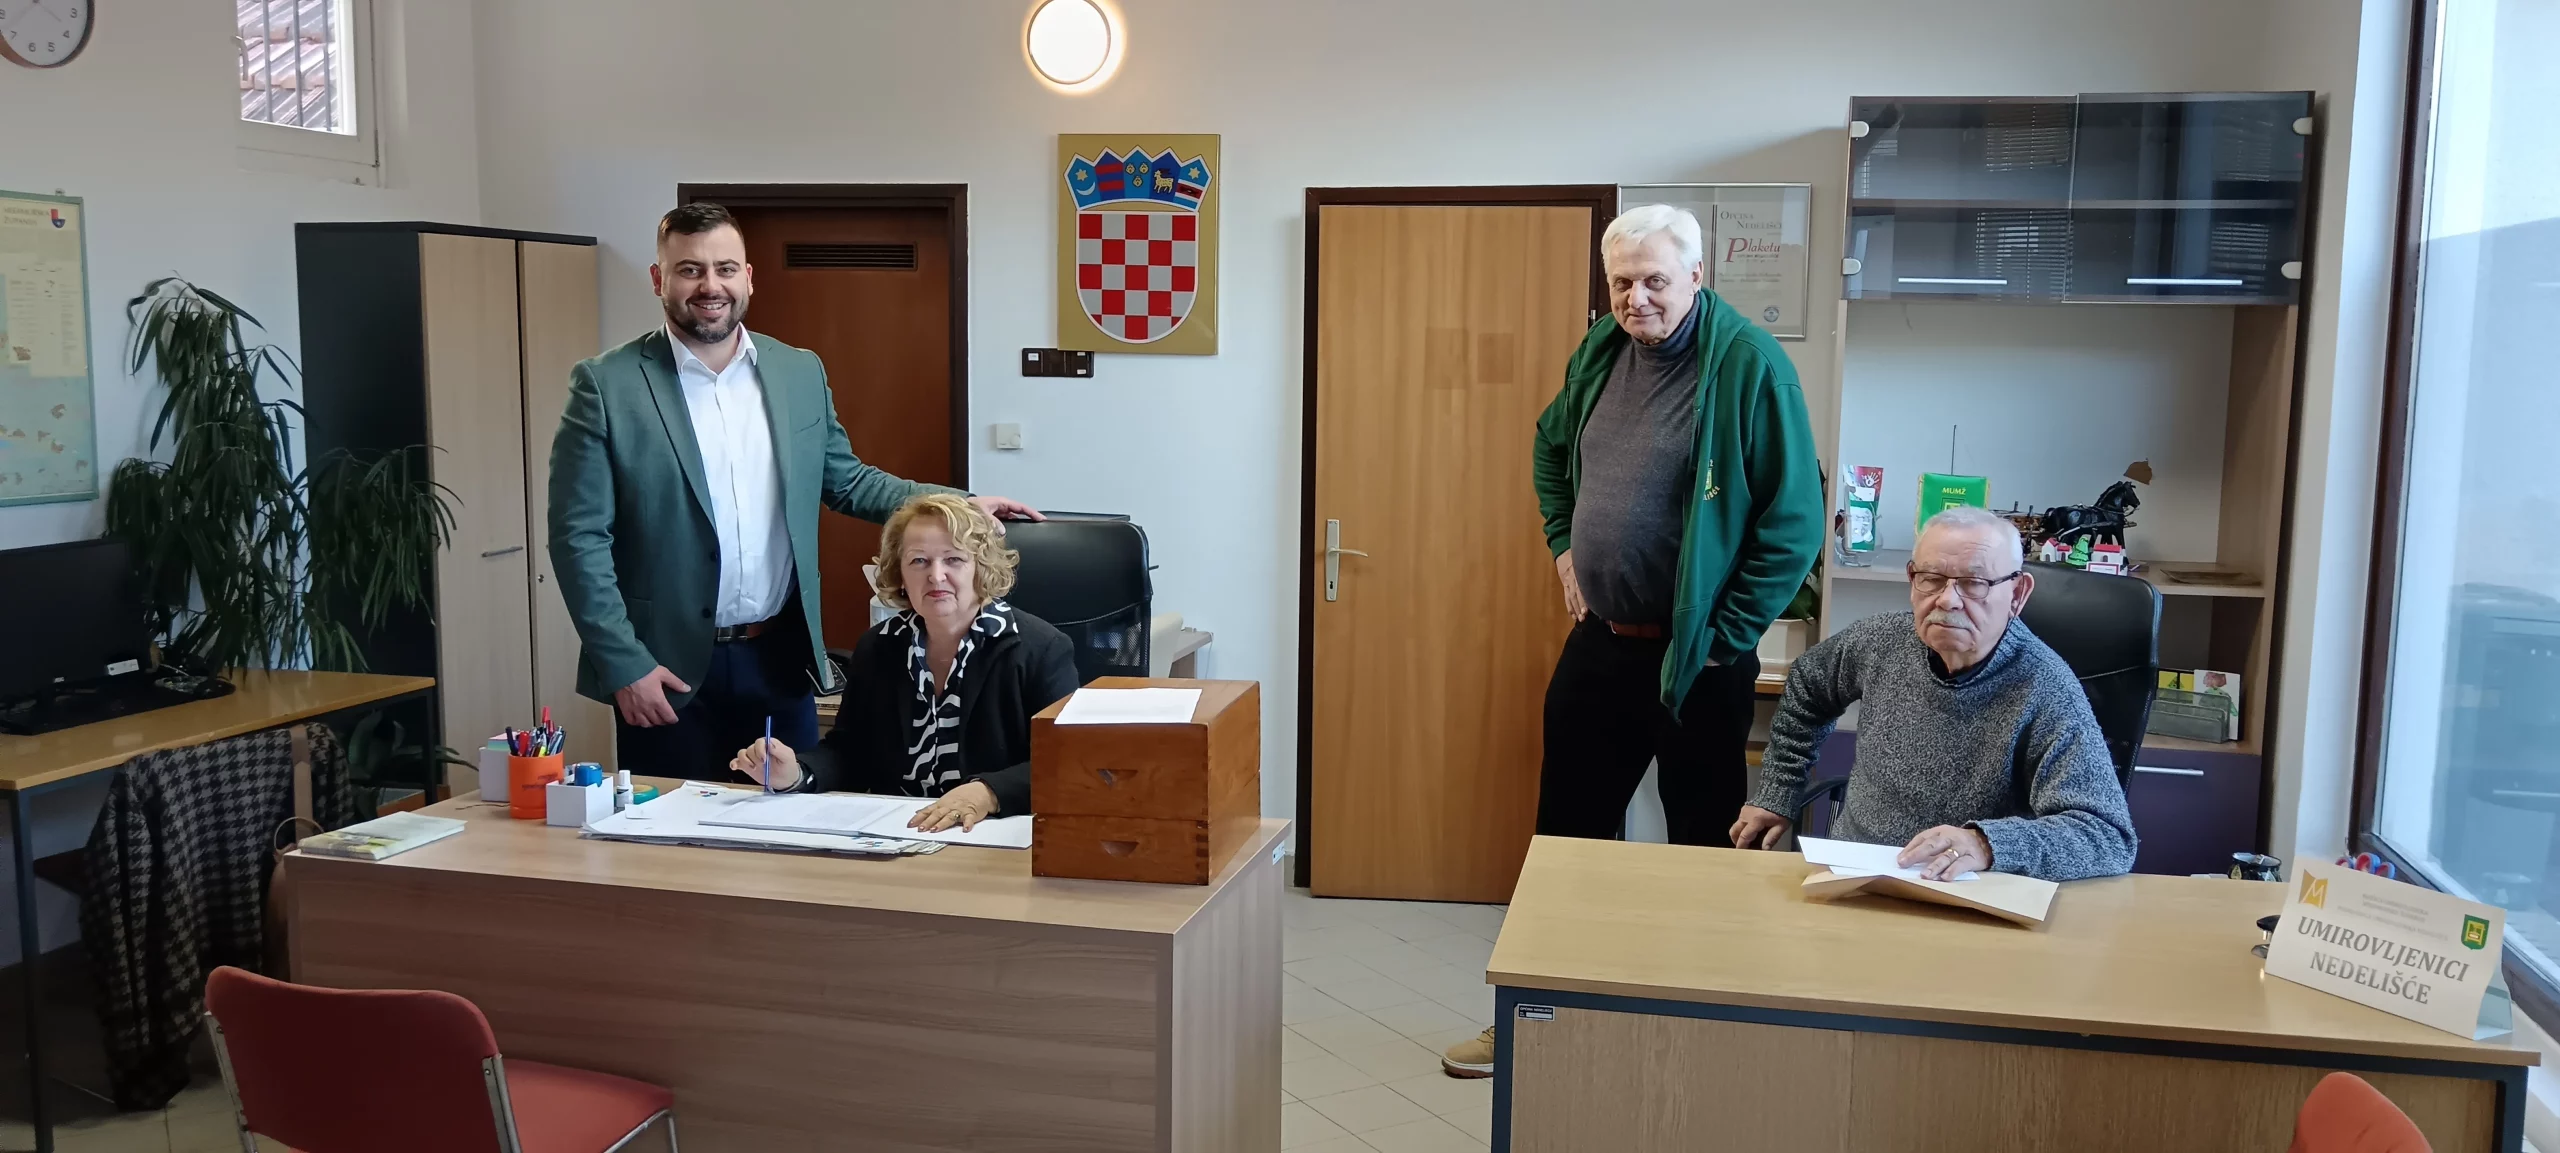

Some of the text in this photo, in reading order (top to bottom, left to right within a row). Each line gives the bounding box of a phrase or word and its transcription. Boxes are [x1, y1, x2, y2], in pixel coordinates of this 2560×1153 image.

[70, 8, 78, 18] 3
[10, 30, 70, 40] 7 4
[28, 42, 56, 52] 6 5
[1723, 237, 1780, 263] Plaketu
[1942, 486, 1967, 495] MUMŽ
[2297, 915, 2470, 983] UMIROVLJENICI
[2309, 951, 2432, 1005] NEDELIŠĆE
